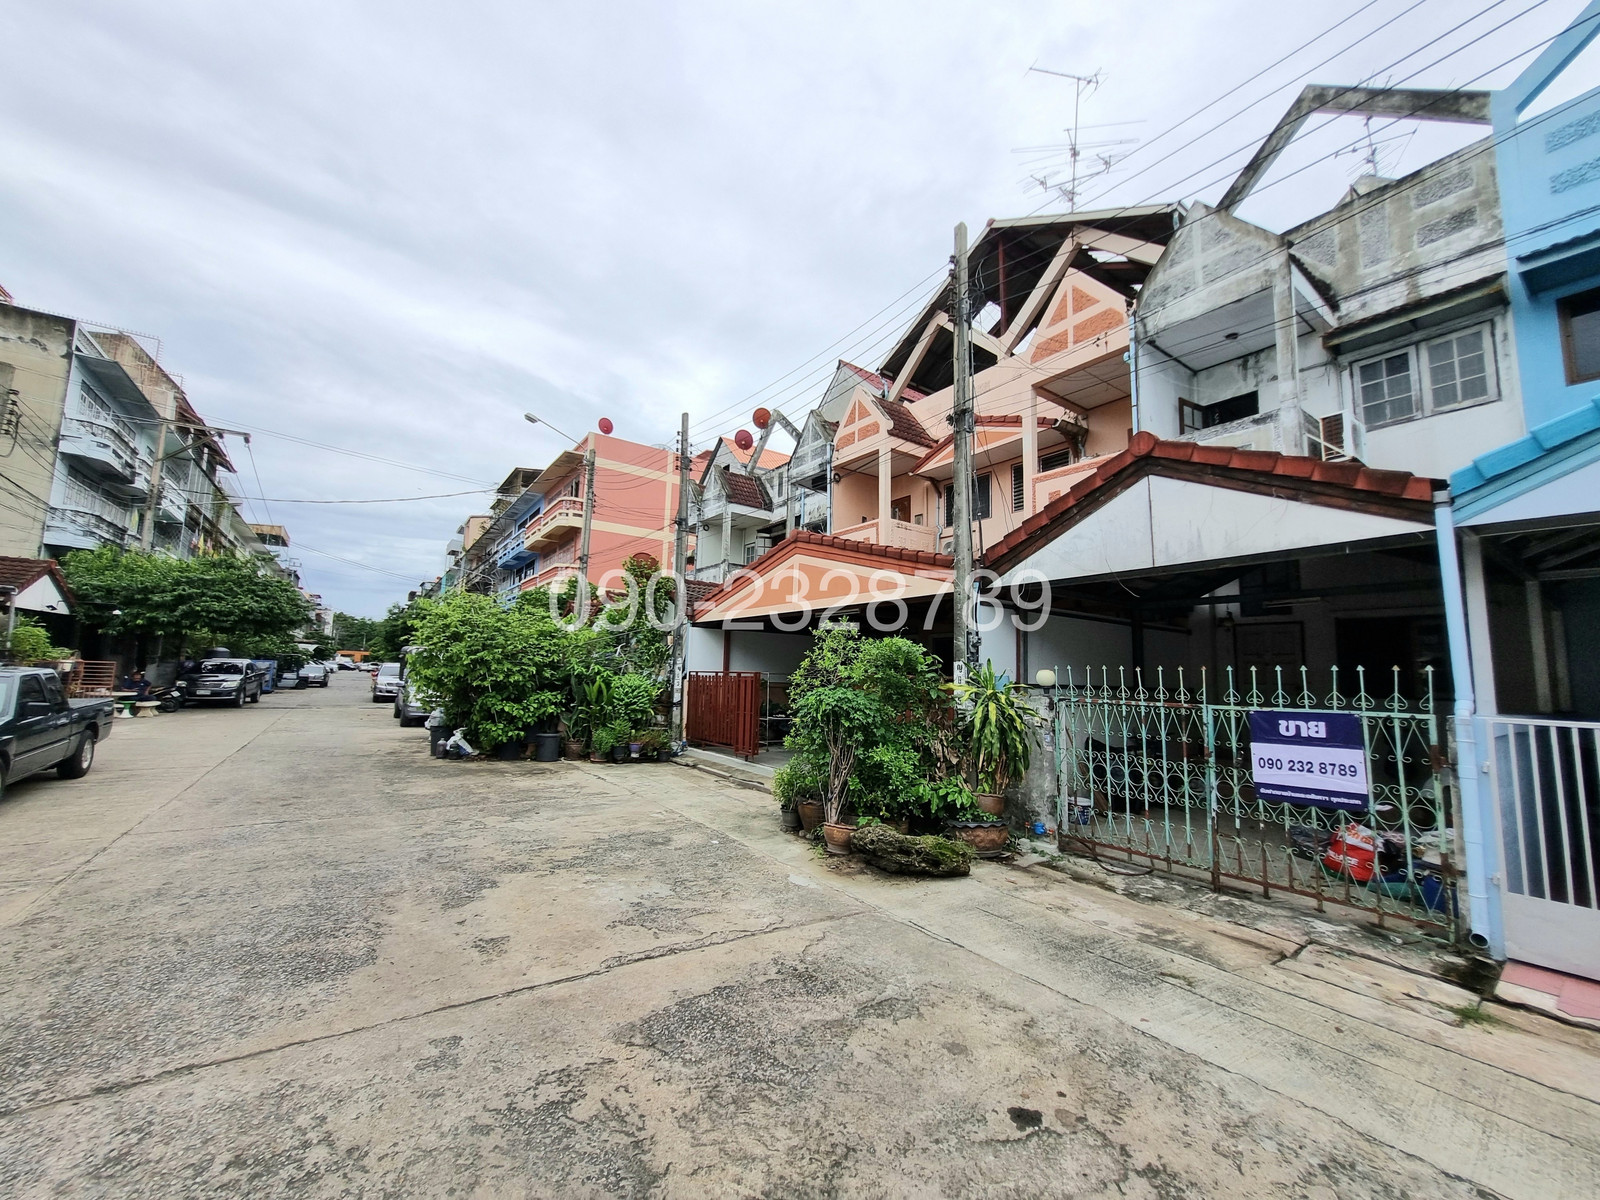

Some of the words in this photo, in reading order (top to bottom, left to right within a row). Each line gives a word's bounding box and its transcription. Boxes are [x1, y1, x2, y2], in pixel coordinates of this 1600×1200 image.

[1278, 720, 1327, 738] ขาย
[1258, 757, 1283, 770] 090
[1288, 759, 1315, 774] 232
[1318, 762, 1358, 778] 8789
